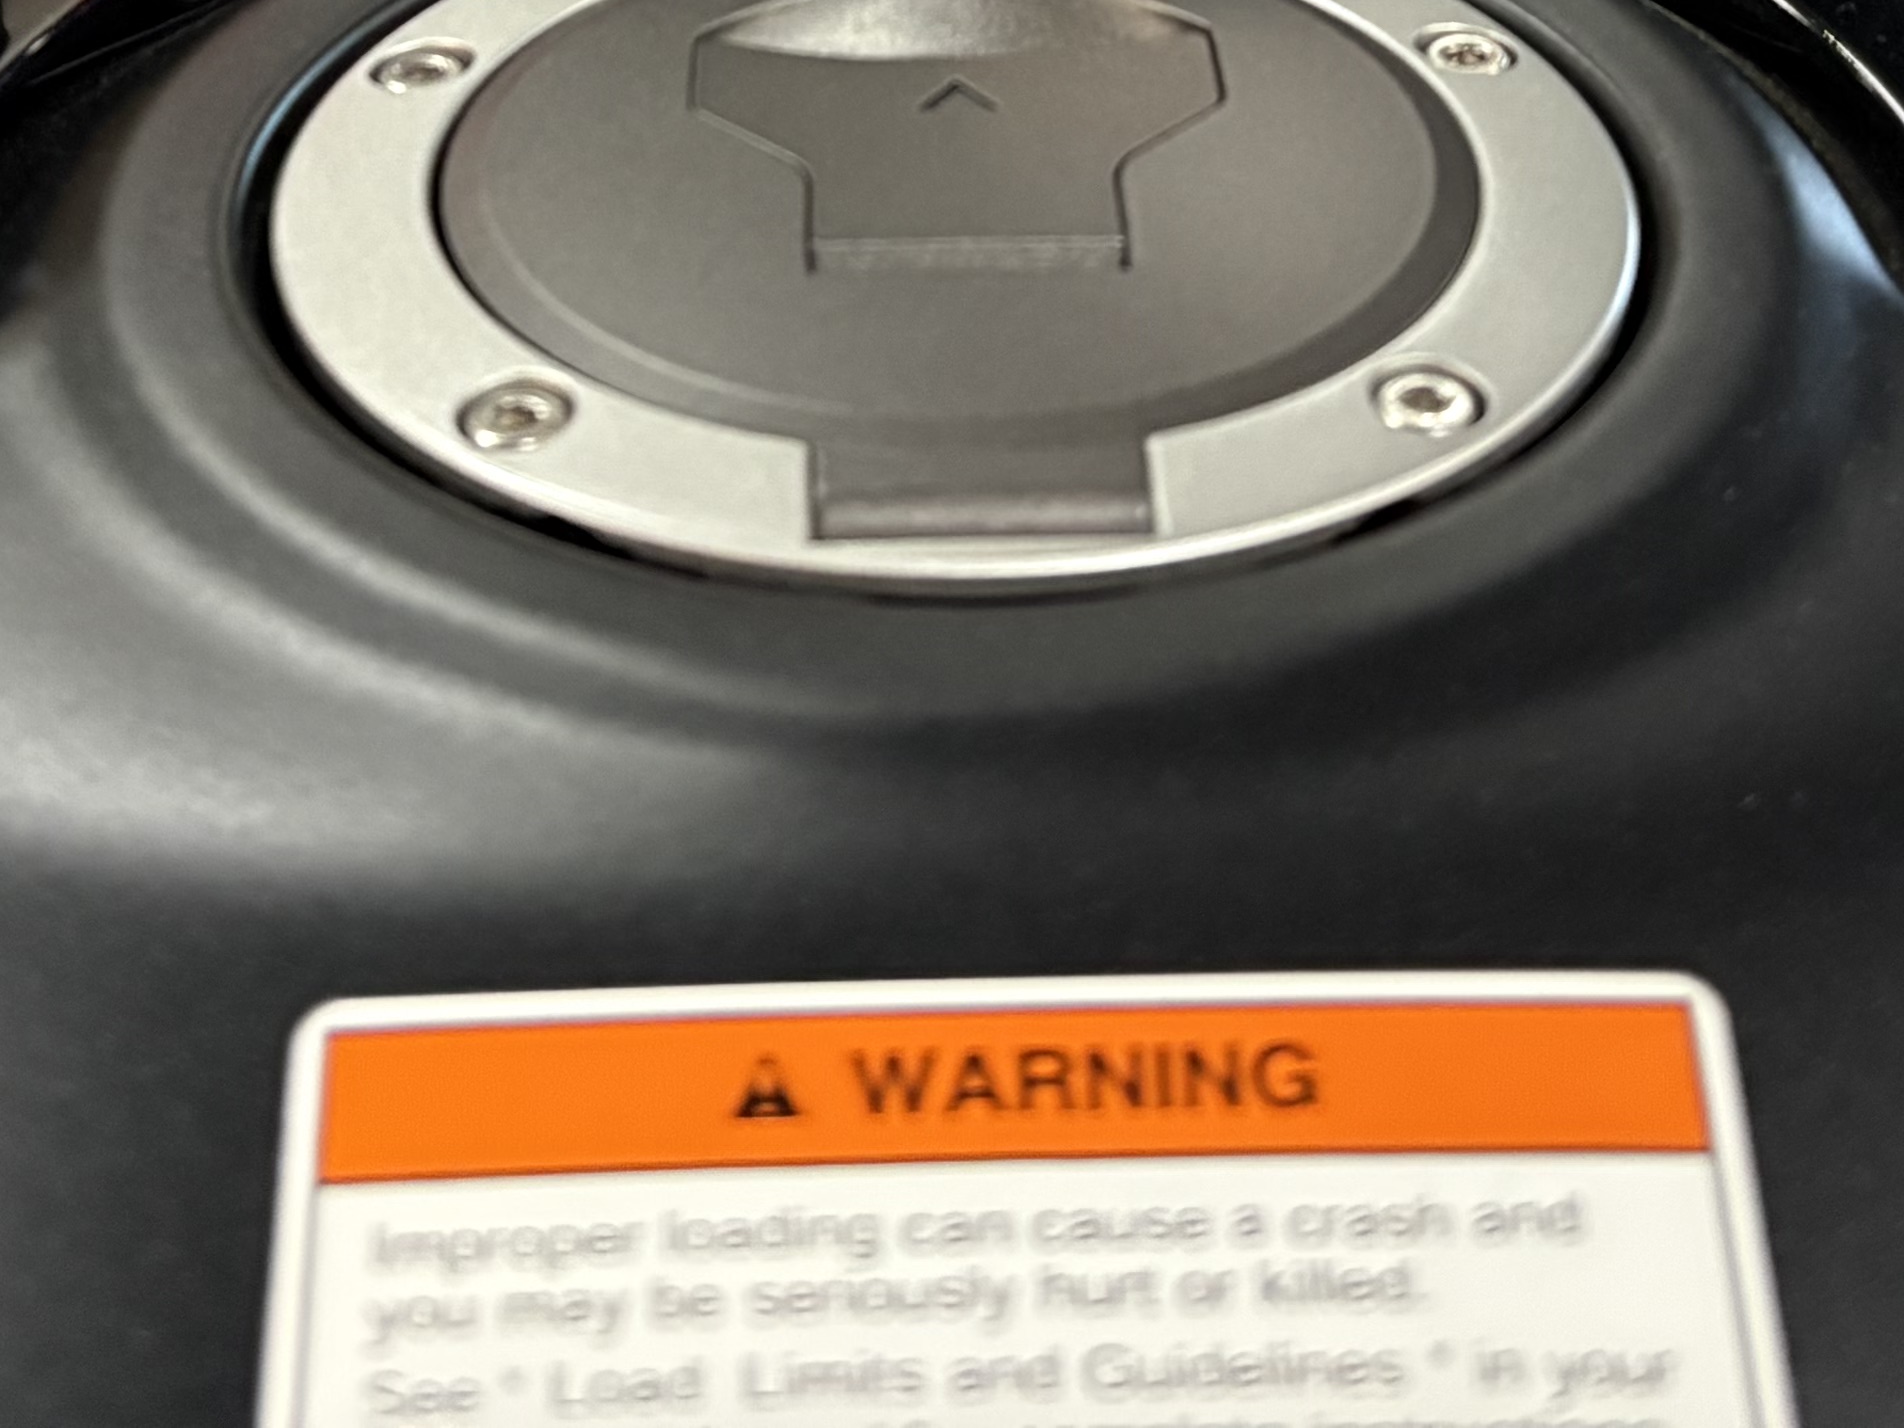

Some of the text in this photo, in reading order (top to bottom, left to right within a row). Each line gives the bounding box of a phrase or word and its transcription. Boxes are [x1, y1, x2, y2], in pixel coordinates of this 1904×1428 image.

[850, 1040, 1321, 1113] WARNING
[370, 1190, 1583, 1277] Improper loading can cause a crash and
[366, 1292, 476, 1344] you
[501, 1286, 622, 1334] may
[650, 1276, 722, 1318] be
[751, 1264, 1010, 1323] seriously
[1041, 1264, 1157, 1308] hurt
[1181, 1270, 1236, 1304] or
[370, 1368, 482, 1414] See
[951, 1344, 1059, 1391] and
[1476, 1346, 1528, 1382] in
[1547, 1347, 1676, 1399] your
